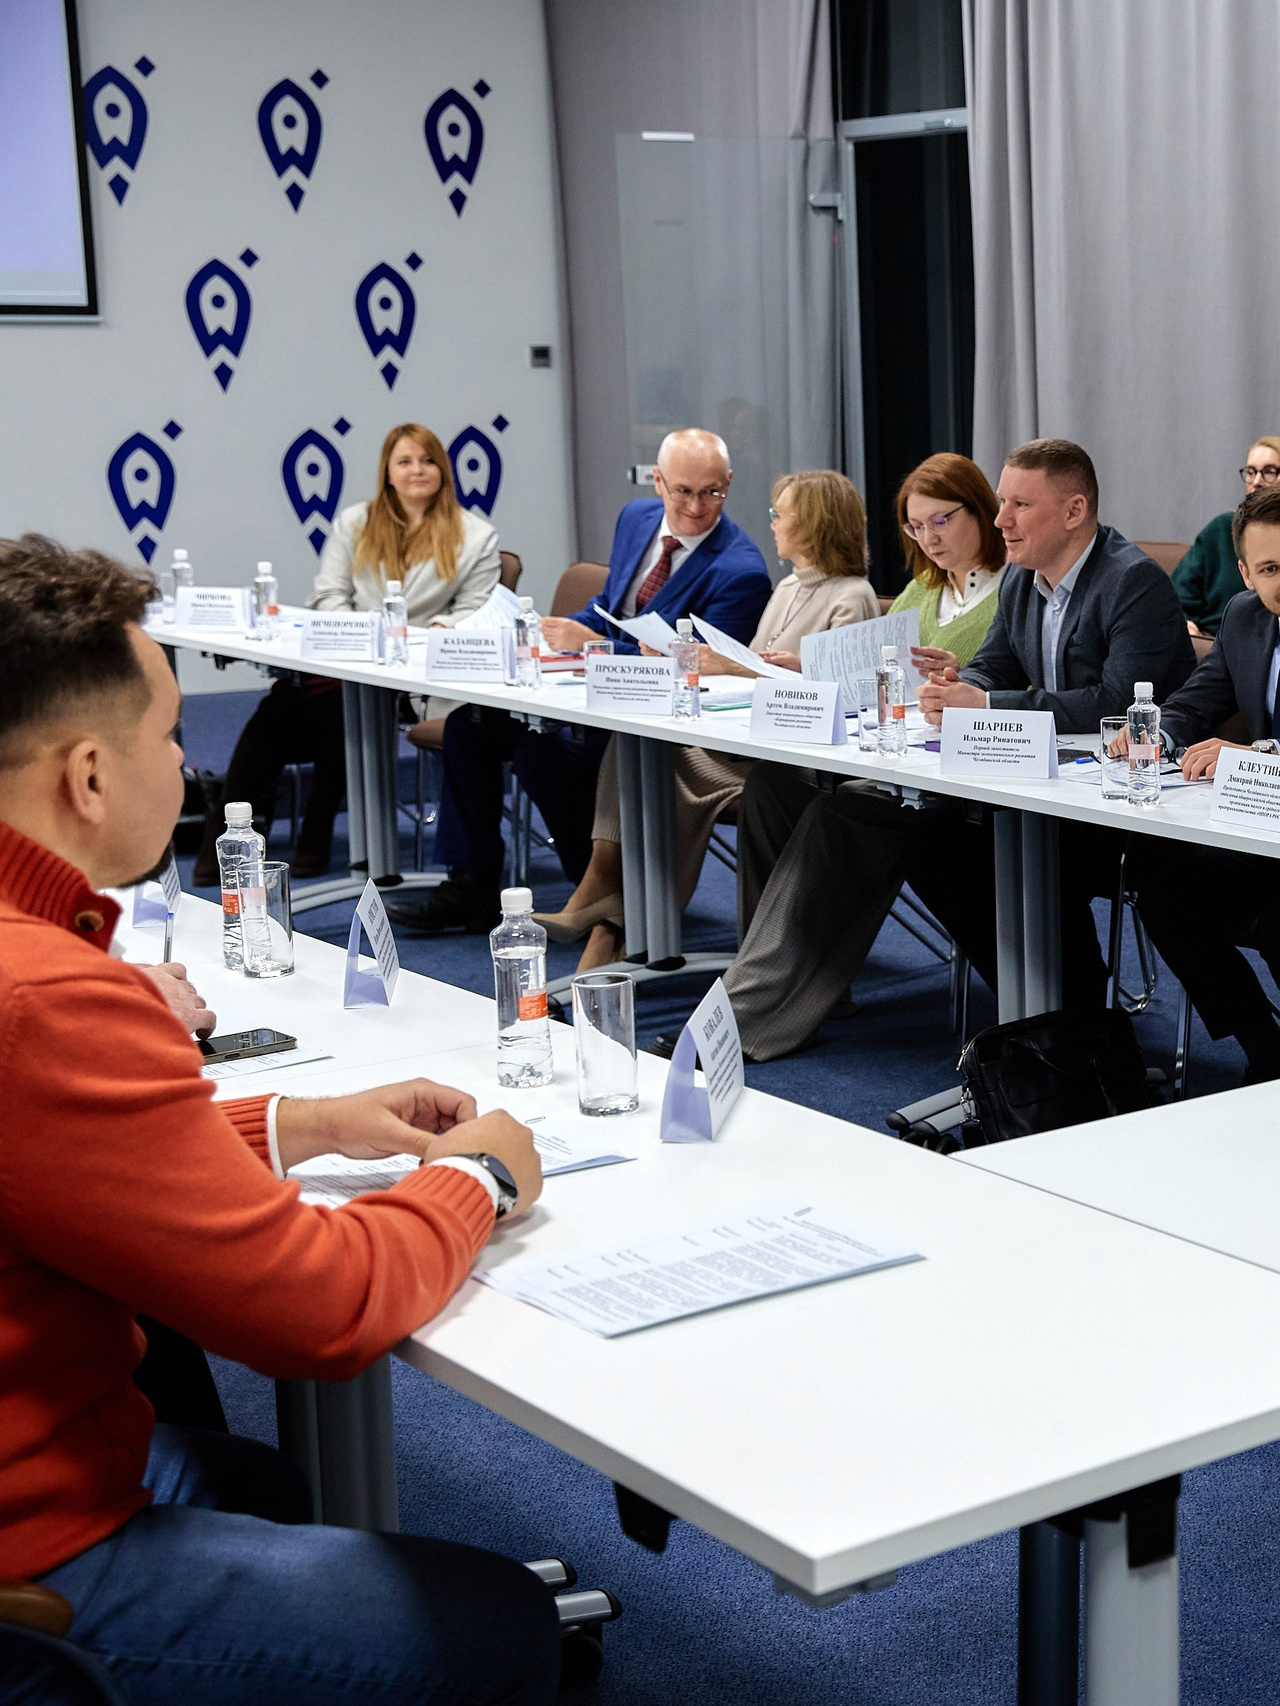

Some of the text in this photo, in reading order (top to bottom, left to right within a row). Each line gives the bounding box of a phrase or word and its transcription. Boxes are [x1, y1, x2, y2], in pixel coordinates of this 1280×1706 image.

[595, 664, 671, 676] ПРОСКУРЯКОВА
[774, 689, 819, 701] НОВИКОВ
[973, 721, 1023, 733] ШАРИЕВ
[963, 734, 1031, 745] Ильмар Ринатович
[1227, 774, 1253, 787] Дмитрий
